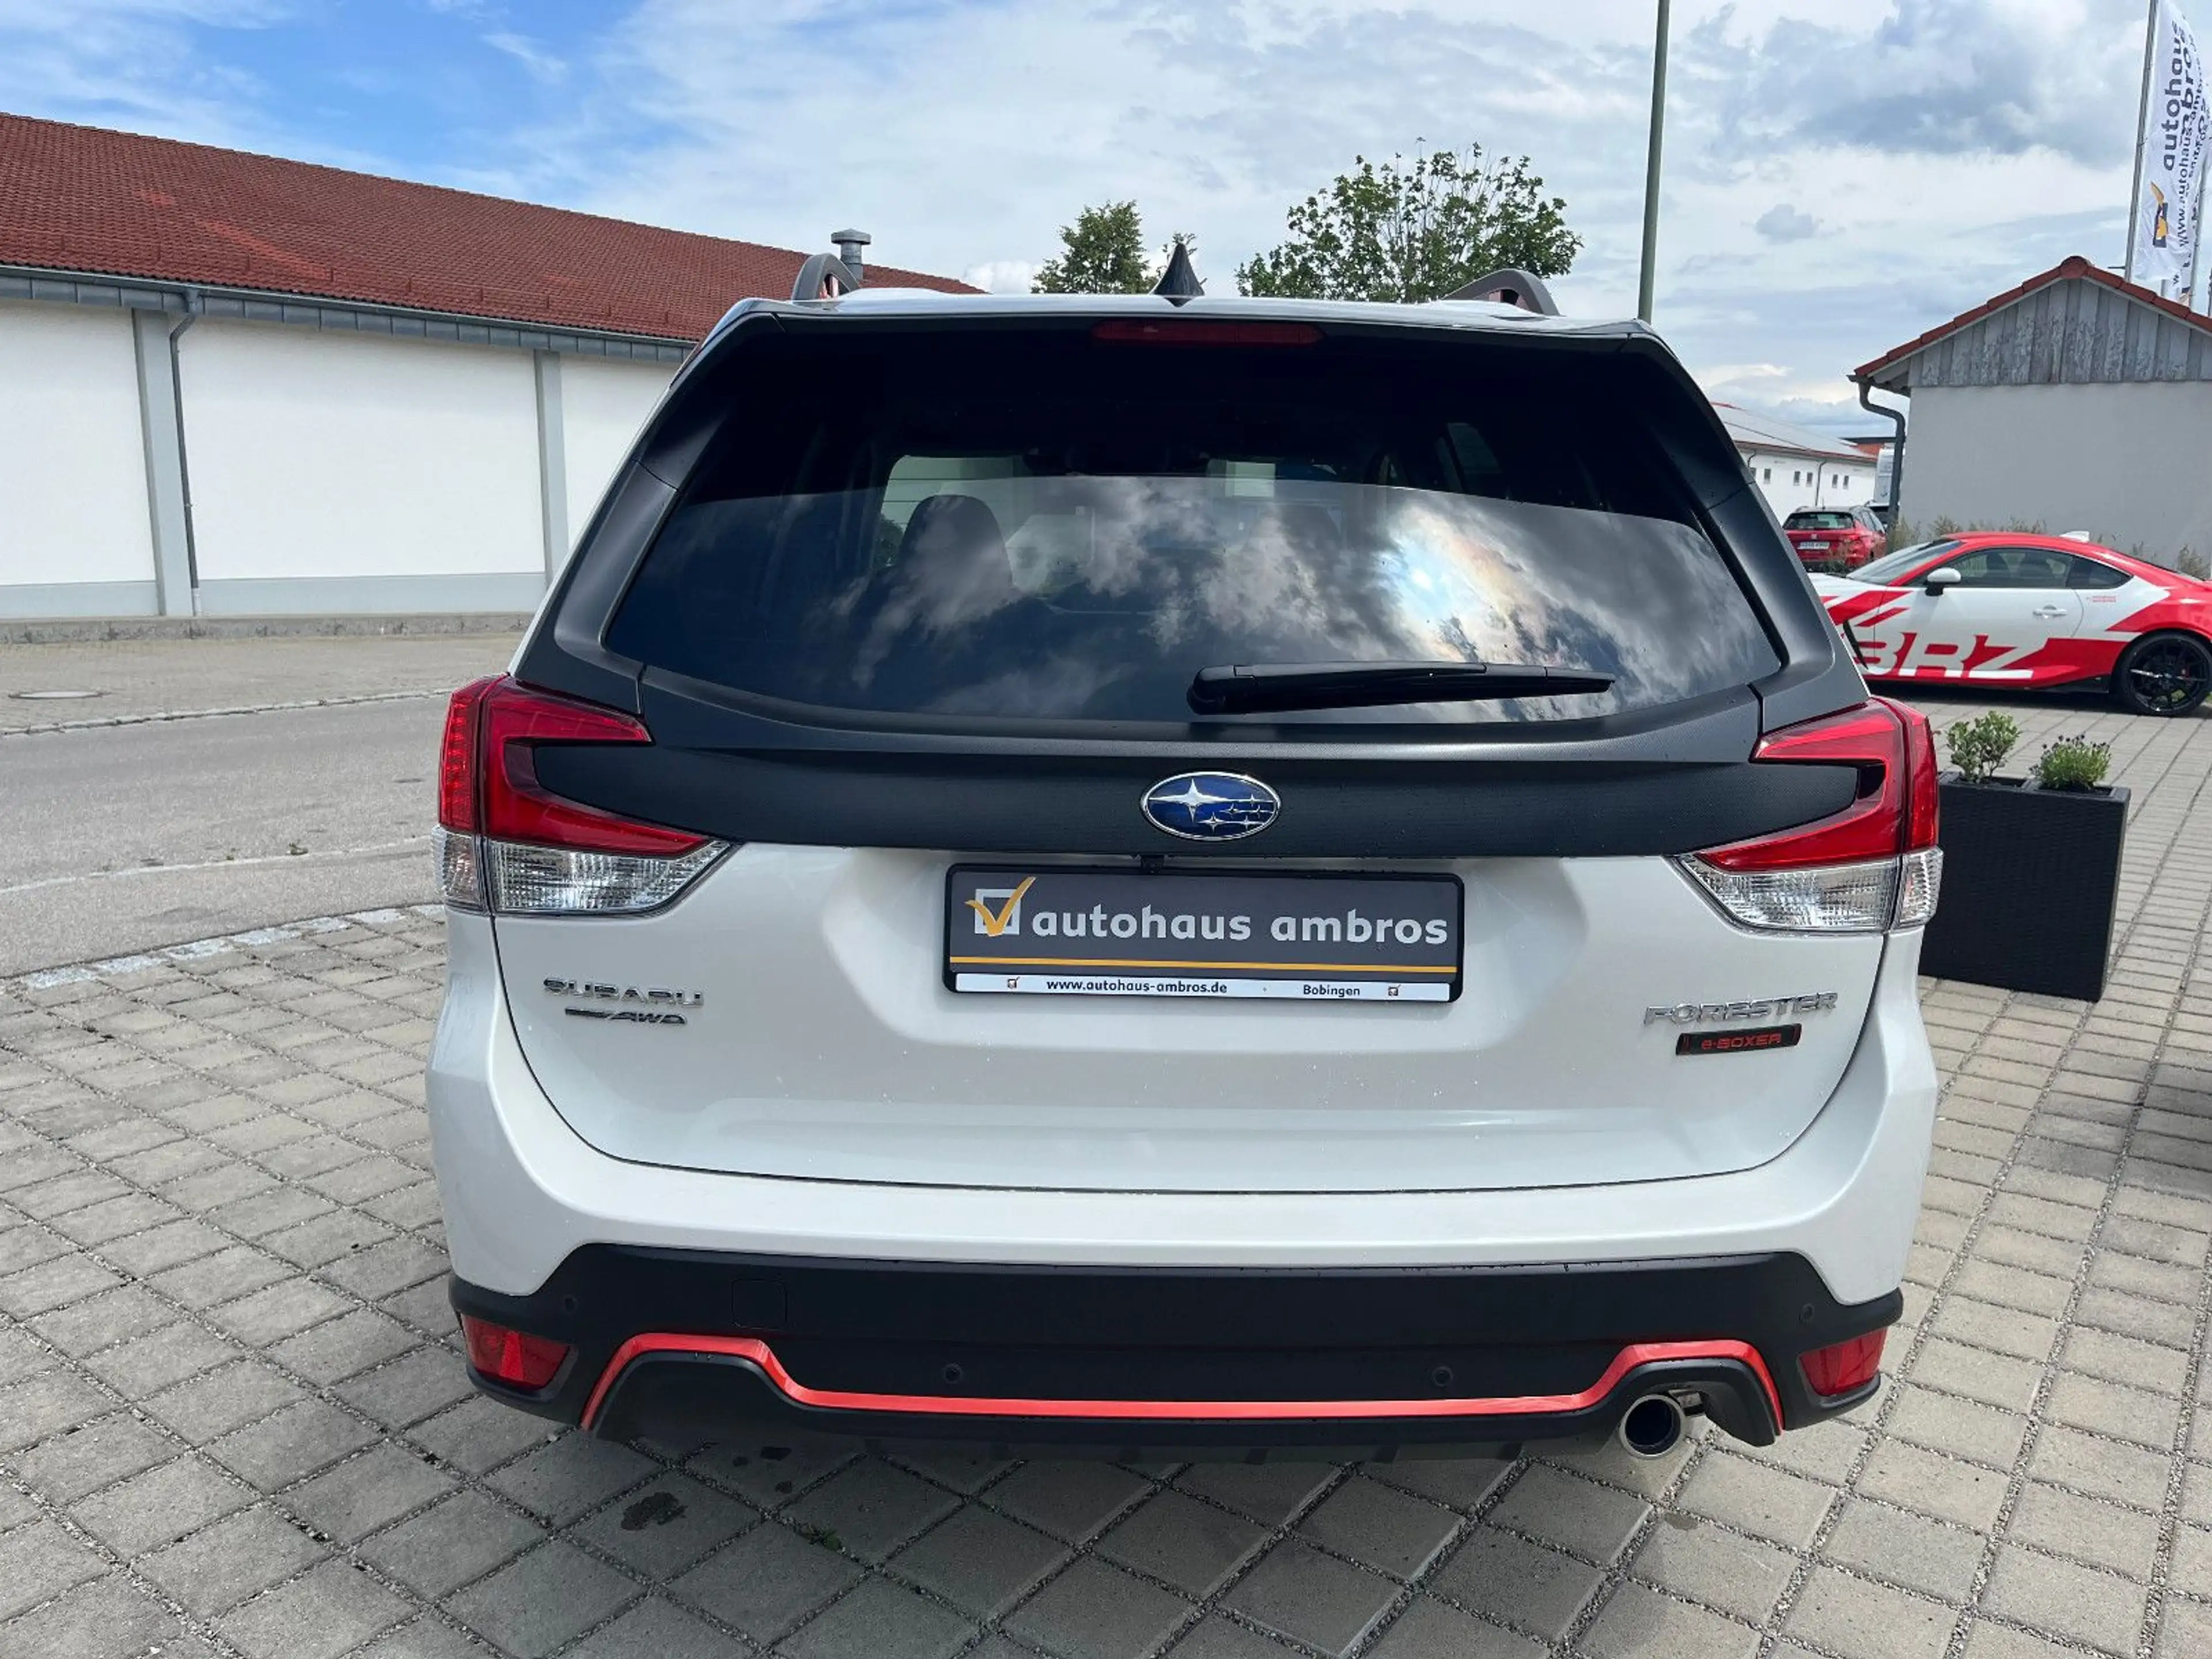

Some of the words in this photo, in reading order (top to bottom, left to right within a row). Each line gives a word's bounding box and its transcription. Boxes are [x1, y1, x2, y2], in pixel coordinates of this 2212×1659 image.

[2161, 21, 2182, 171] autohaus
[1846, 632, 2045, 679] BRZ
[1032, 902, 1251, 941] autohaus
[1270, 908, 1448, 944] ambros
[543, 978, 704, 1007] SUBARU
[1047, 980, 1228, 995] www.autohaus-ambros.de
[1302, 983, 1361, 998] Bobingen
[608, 1011, 685, 1024] AWD
[1643, 992, 1838, 1025] FORESTER
